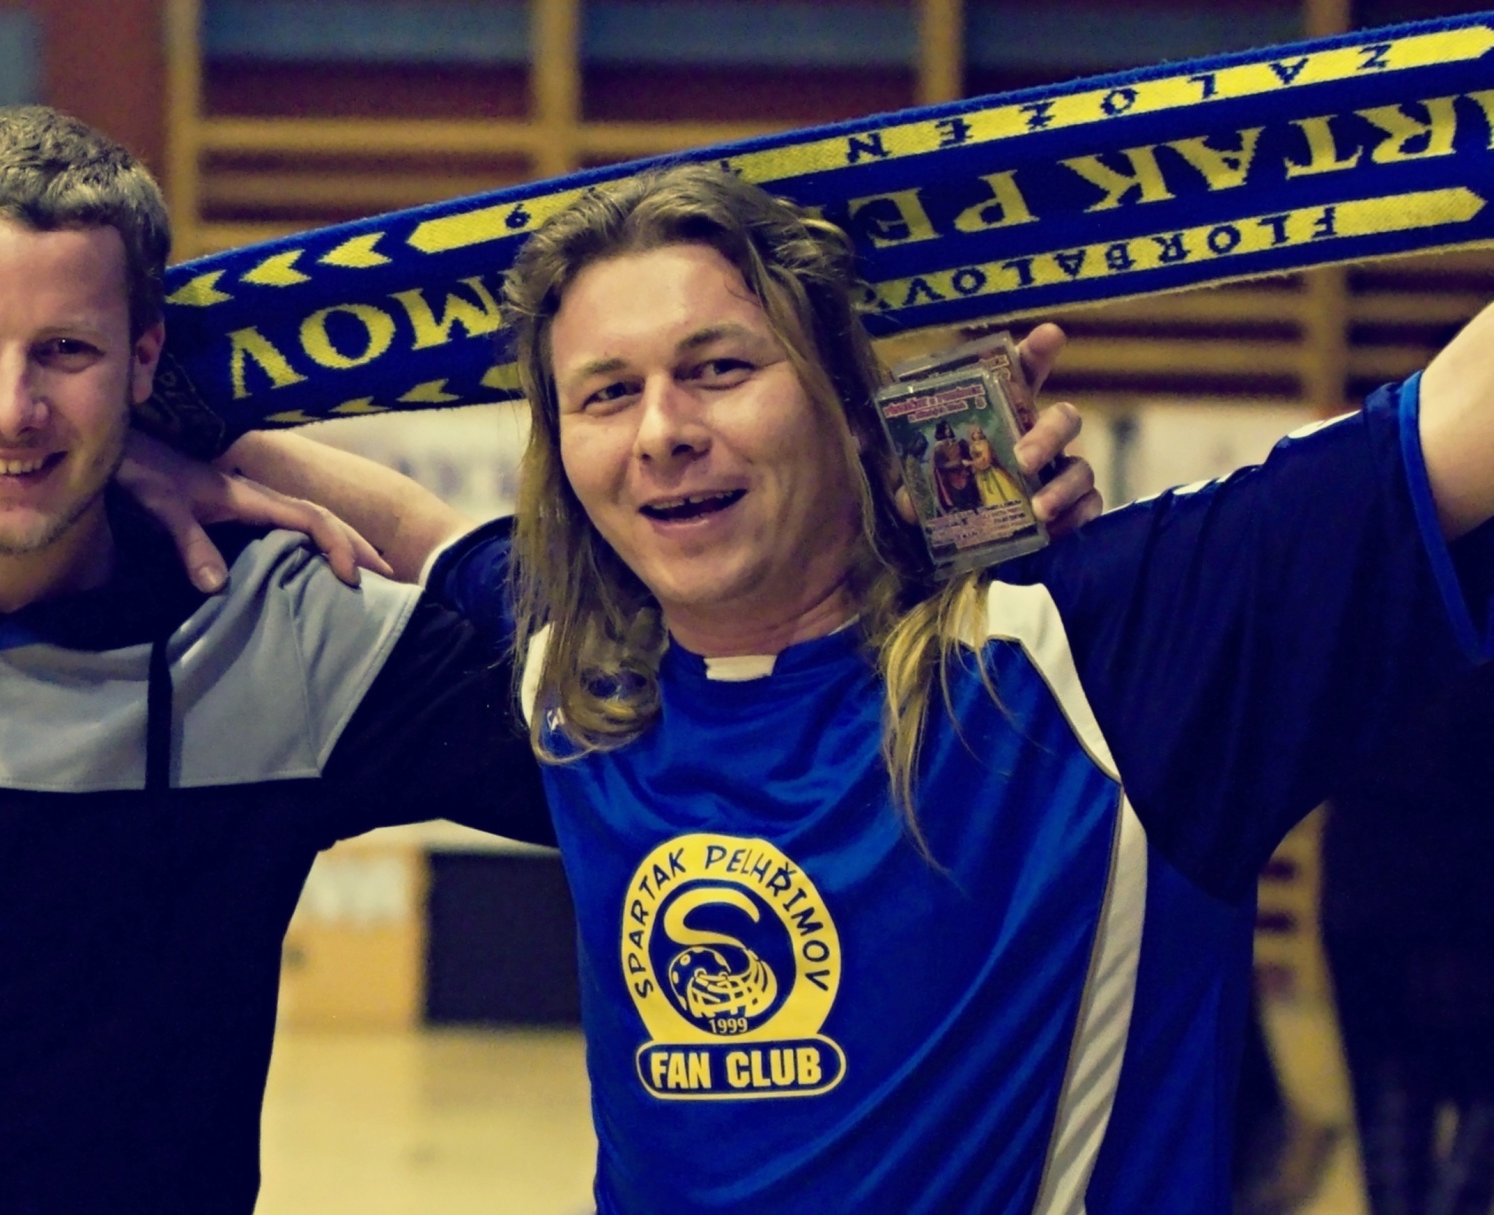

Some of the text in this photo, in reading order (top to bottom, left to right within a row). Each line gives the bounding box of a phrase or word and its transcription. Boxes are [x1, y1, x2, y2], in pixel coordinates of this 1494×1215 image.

[831, 168, 1040, 250] PE
[226, 272, 512, 400] MOV
[628, 845, 832, 999] SPARTAK PELHŘIMOV
[708, 1017, 749, 1034] 1999
[650, 1047, 822, 1090] FAN CLUB
